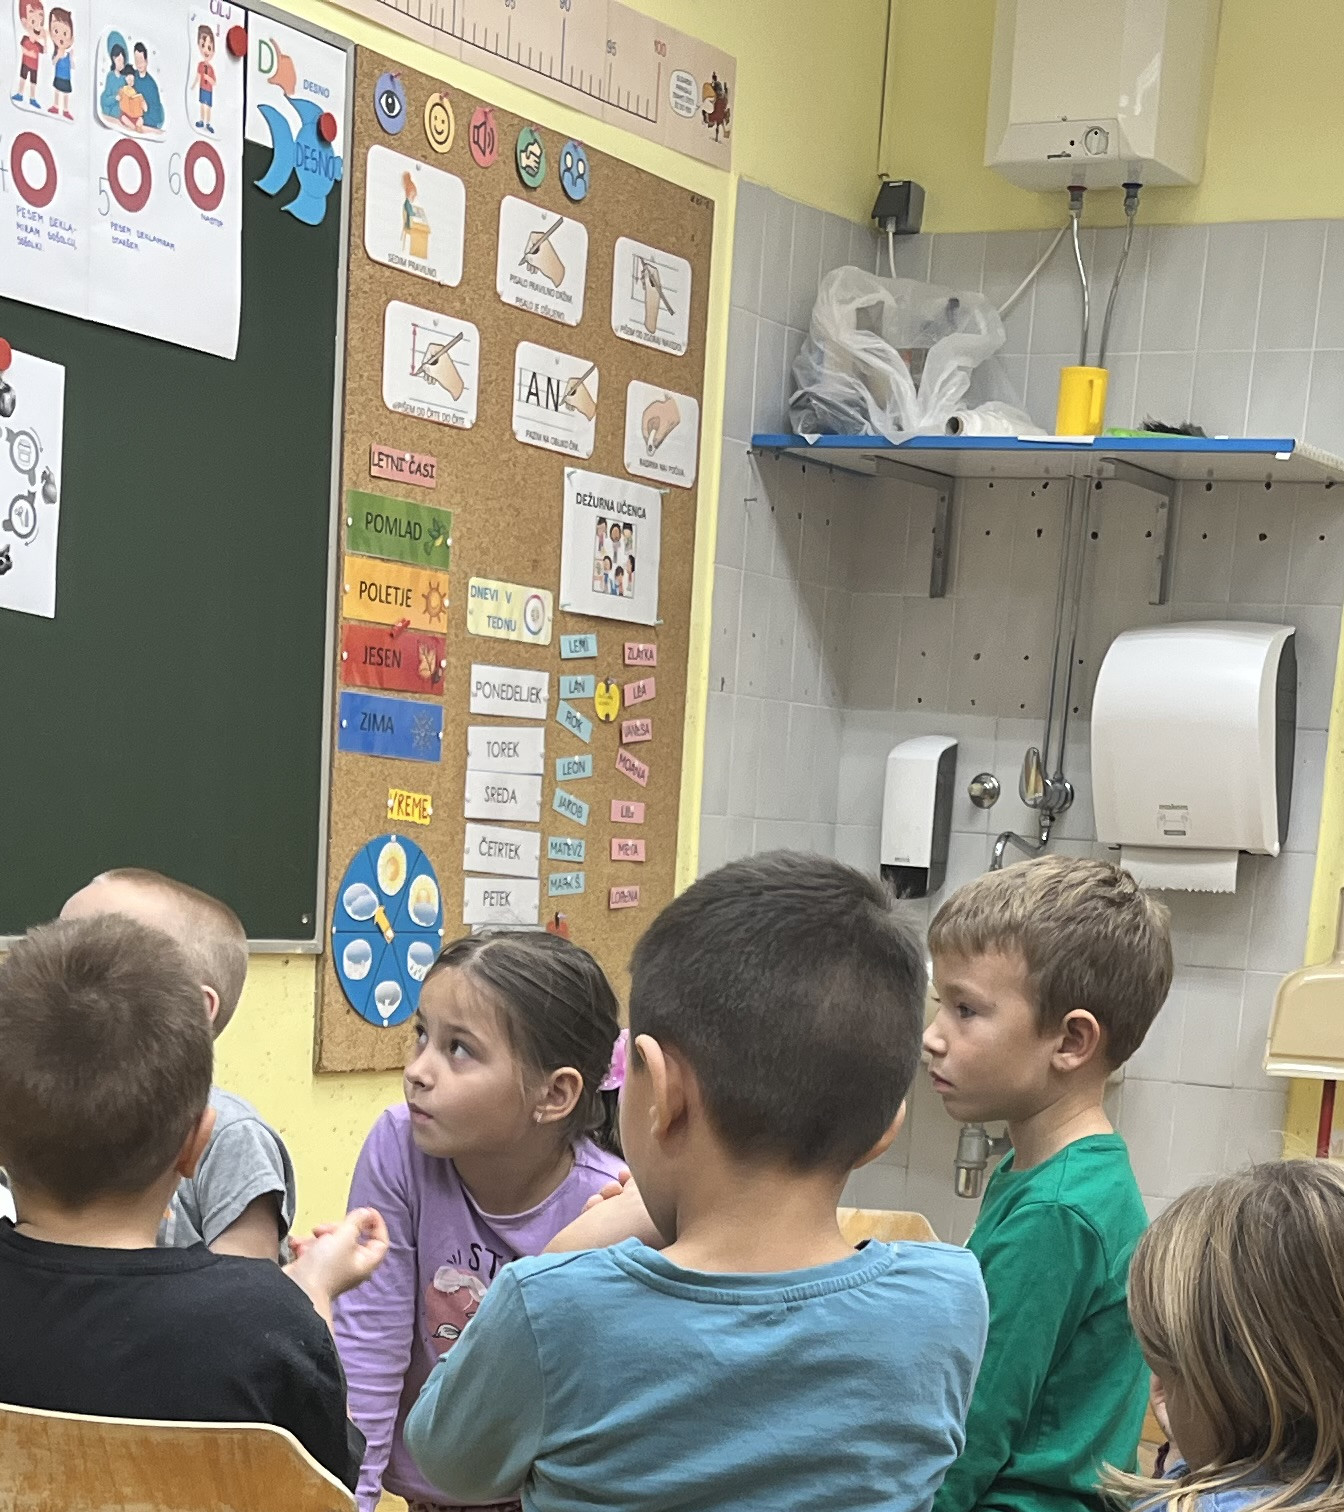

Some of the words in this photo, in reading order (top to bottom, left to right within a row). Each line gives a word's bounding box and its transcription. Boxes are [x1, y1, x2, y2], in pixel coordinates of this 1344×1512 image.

[258, 38, 275, 75] D
[302, 78, 331, 99] DESNO
[294, 140, 336, 182] DESNO
[372, 450, 404, 473] LETNI
[407, 454, 435, 480] ČASI
[575, 491, 616, 514] DEŽURNA
[365, 510, 422, 541] POMLAD
[359, 580, 413, 608] POLETJE
[470, 584, 499, 603] DNEVI
[504, 590, 513, 605] V
[486, 614, 517, 633] TEDNU
[362, 644, 403, 670] JESEN
[475, 680, 543, 705] PONEDELJEK
[359, 710, 395, 736] ZIMA
[486, 740, 520, 759] TOREK
[389, 789, 430, 820] VREME
[484, 785, 518, 806] SREDA
[478, 835, 522, 861] ČETRTEK
[482, 890, 513, 908] PETEK
